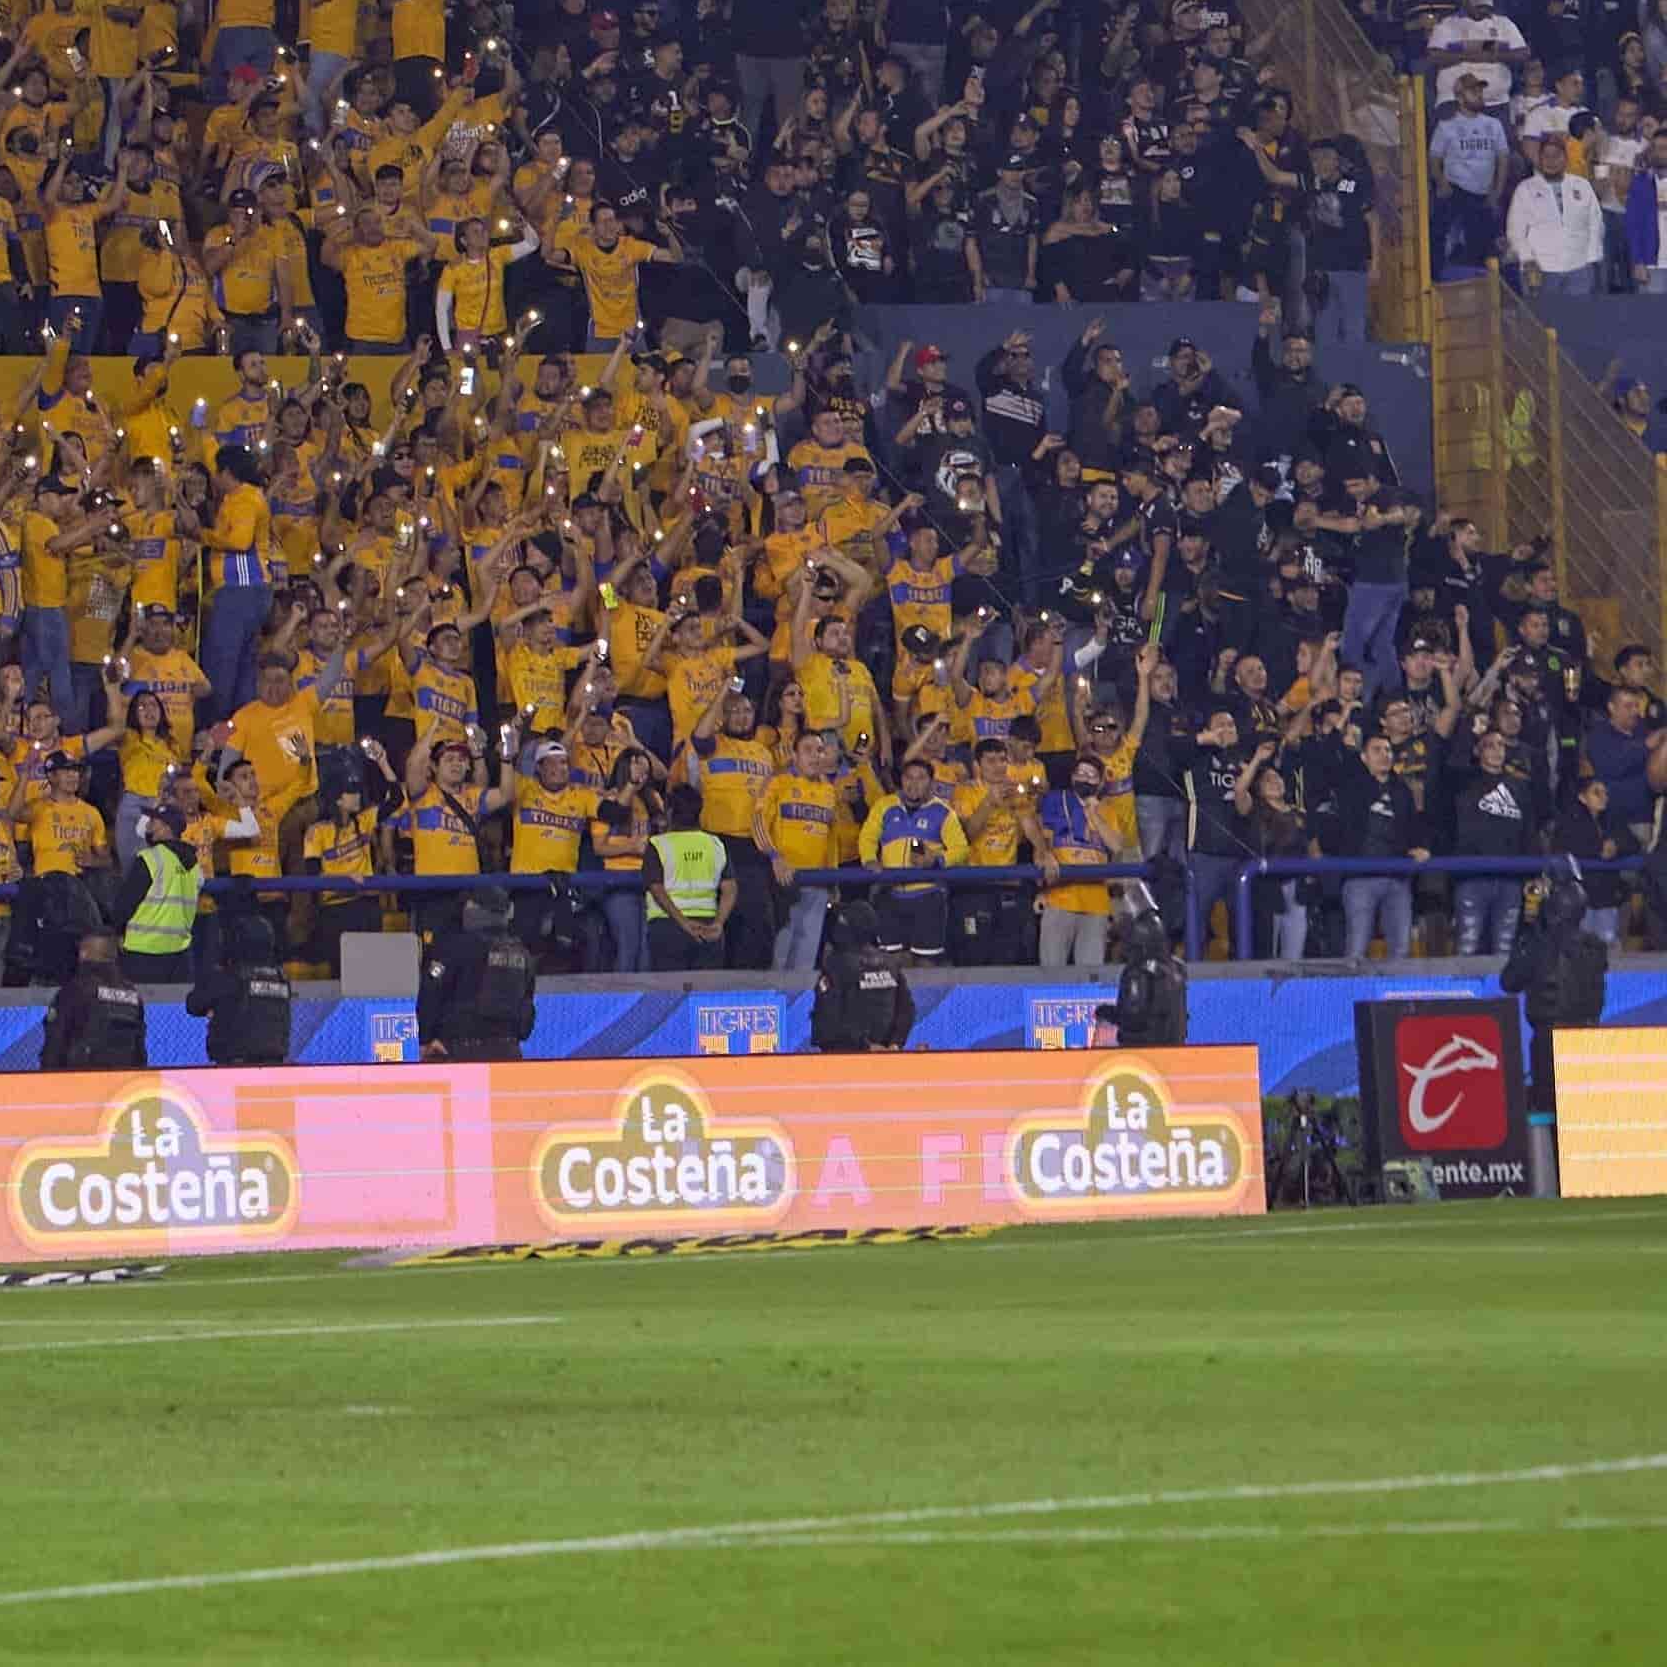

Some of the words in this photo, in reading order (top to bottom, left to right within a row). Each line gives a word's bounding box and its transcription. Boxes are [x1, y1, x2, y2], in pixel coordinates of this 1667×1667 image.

[531, 811, 580, 831] TIGRES
[1478, 797, 1522, 819] adidas
[698, 1008, 778, 1032] TIGRES
[641, 1096, 688, 1142] La
[1106, 1085, 1150, 1130] La
[131, 1109, 184, 1158] La
[559, 1141, 770, 1207] Costeña
[1029, 1128, 1228, 1194] Costeña
[1433, 1160, 1524, 1186] ente.mx
[39, 1157, 270, 1226] Costeña
